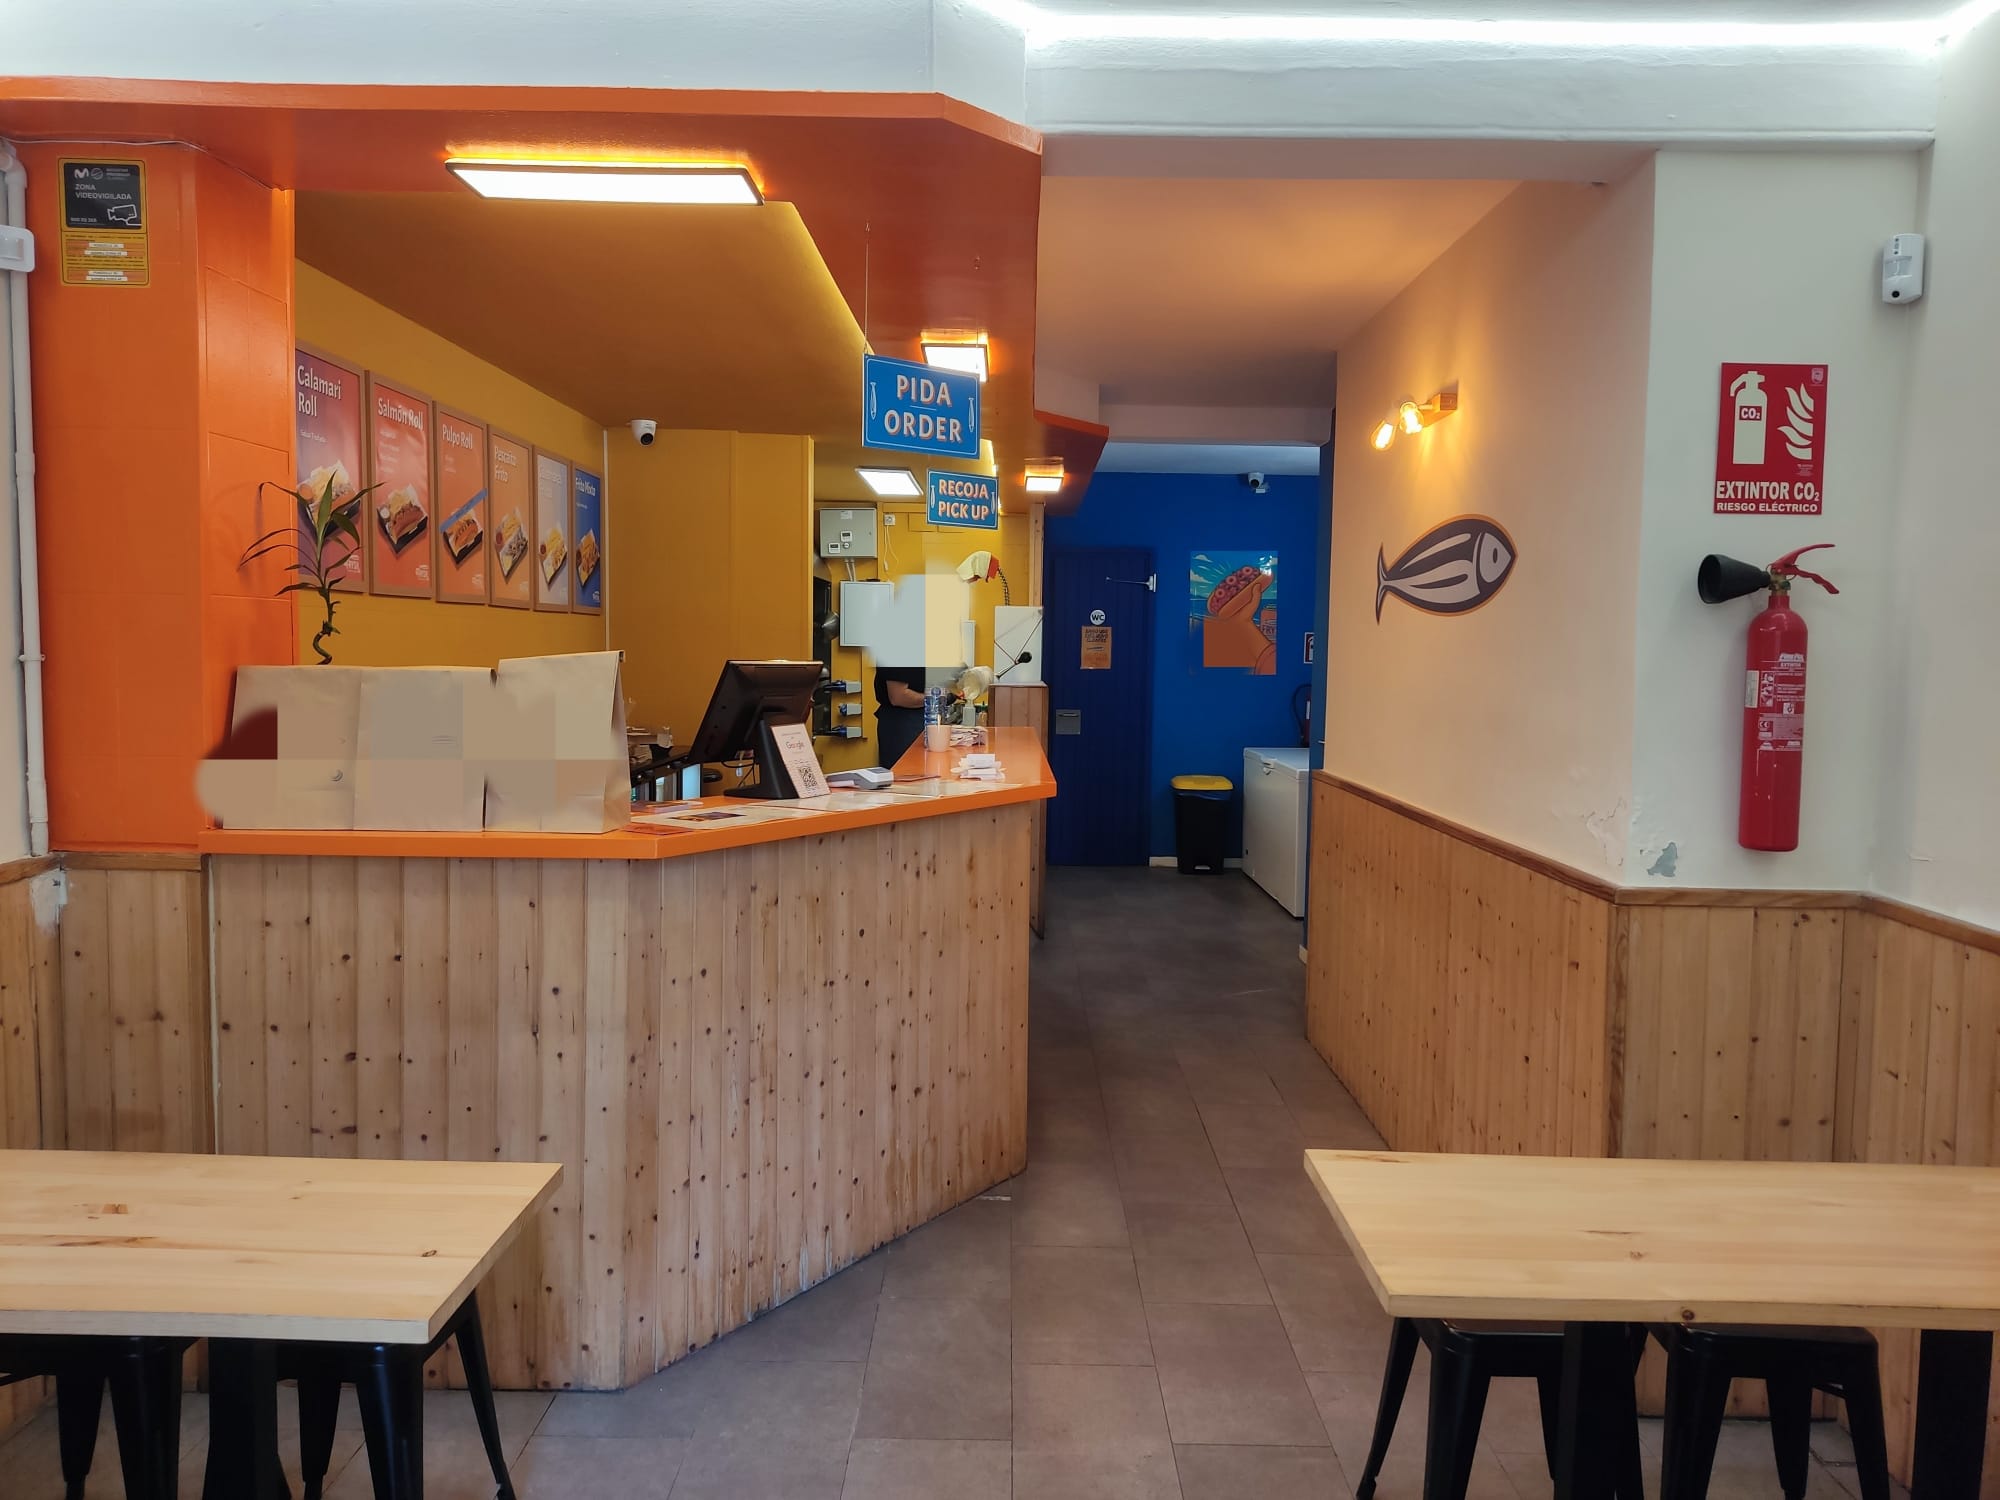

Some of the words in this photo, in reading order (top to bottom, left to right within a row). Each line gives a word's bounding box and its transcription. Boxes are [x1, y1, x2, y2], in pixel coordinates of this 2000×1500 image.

[297, 365, 342, 400] Calamari
[897, 374, 953, 408] PIDA
[298, 391, 318, 417] Roll
[378, 397, 408, 425] Salmón
[408, 407, 425, 431] Roll
[442, 423, 460, 448] Pulpo
[461, 431, 473, 449] Roll
[884, 409, 963, 444] ORDER
[938, 478, 989, 500] RECOJA
[1716, 481, 1790, 500] EXTINTOR
[938, 501, 969, 519] PICK
[971, 504, 989, 521] UP
[1716, 503, 1756, 512] RIESGO
[1758, 501, 1818, 512] ELÉCTRICO
